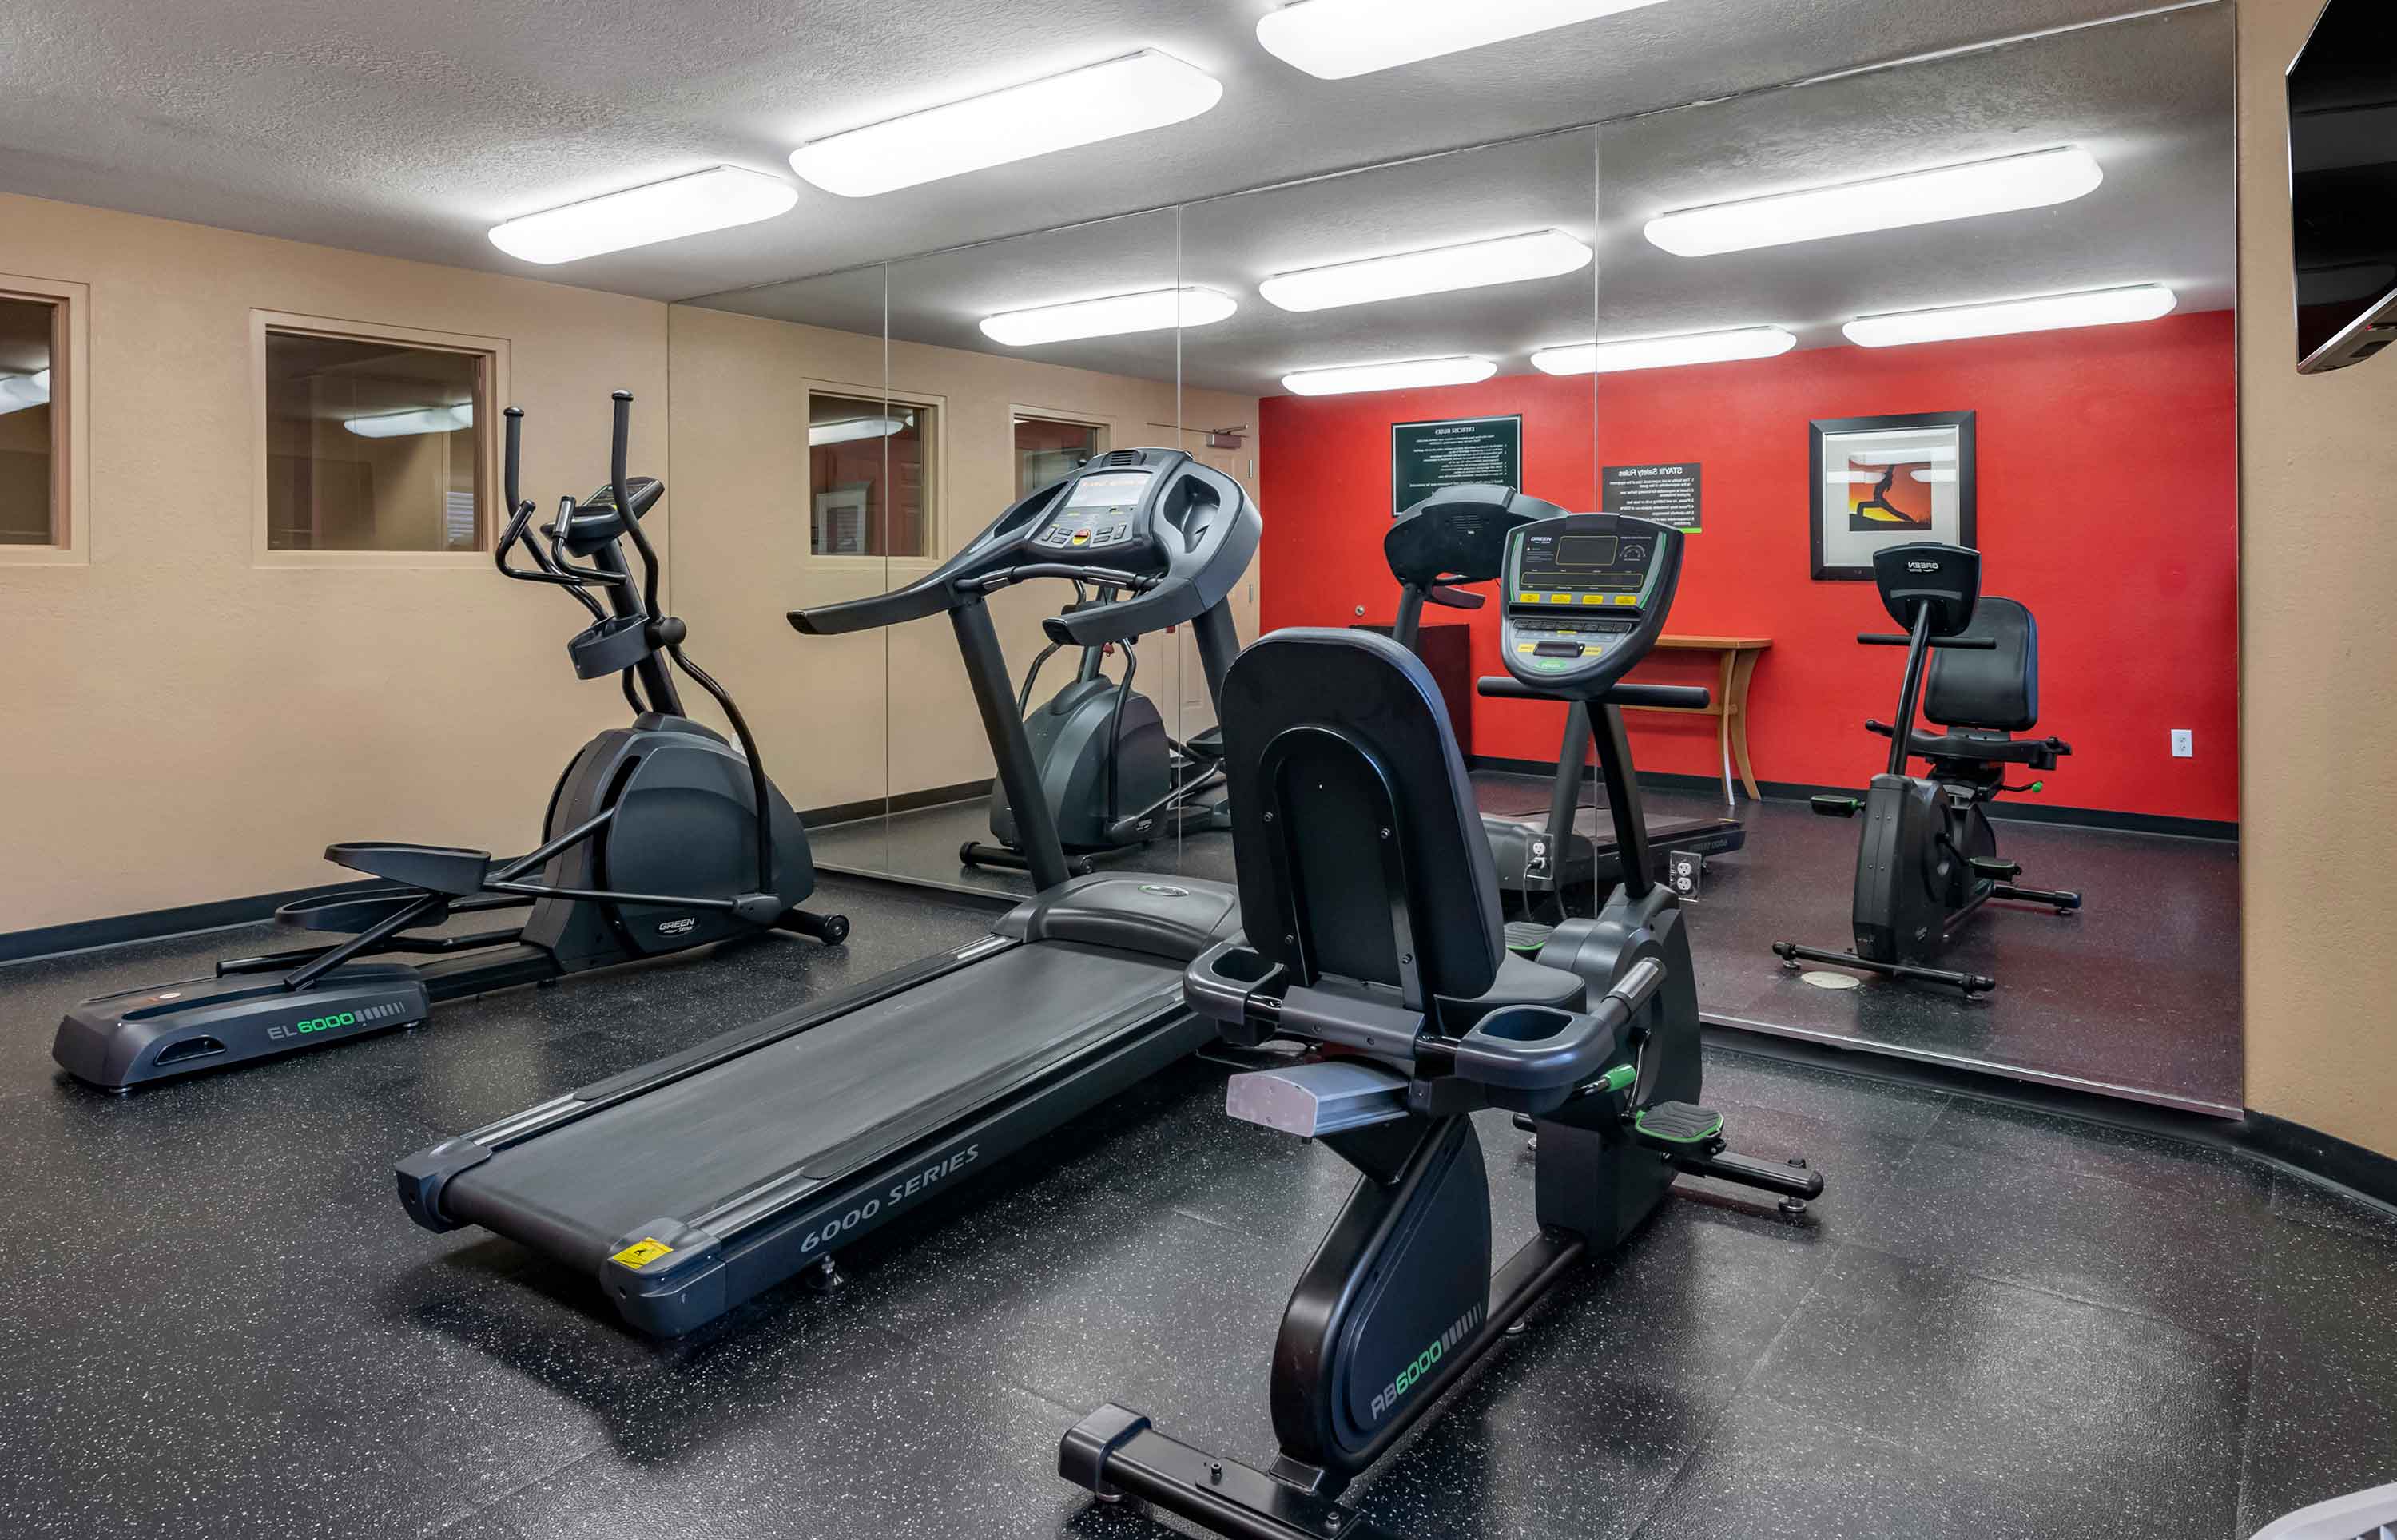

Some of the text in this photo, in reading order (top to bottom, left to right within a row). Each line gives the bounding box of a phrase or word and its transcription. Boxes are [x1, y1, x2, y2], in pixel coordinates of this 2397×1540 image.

[659, 918, 694, 930] GREEN
[800, 1143, 979, 1253] 6000 SERIES
